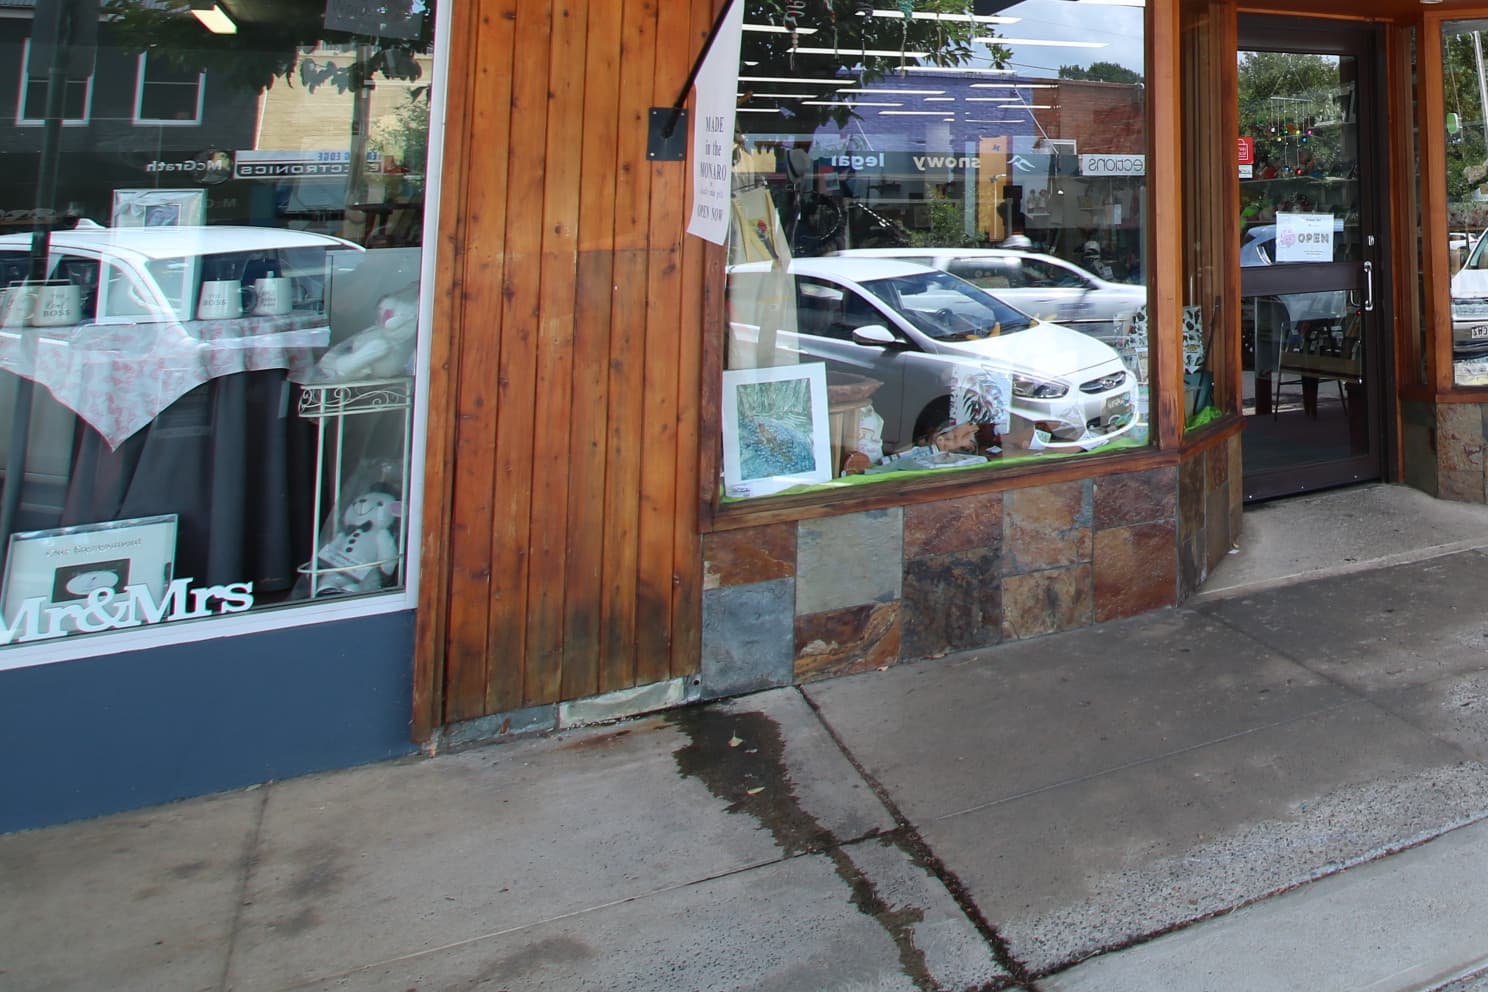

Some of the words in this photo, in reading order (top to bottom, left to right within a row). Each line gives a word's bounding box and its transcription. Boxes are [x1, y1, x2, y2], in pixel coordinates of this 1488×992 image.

[706, 116, 724, 133] MADE
[705, 139, 711, 156] in
[712, 139, 722, 157] the
[700, 161, 727, 182] MONARO
[697, 204, 710, 219] OPEN
[711, 208, 723, 222] NOW
[1298, 233, 1329, 244] OPEN
